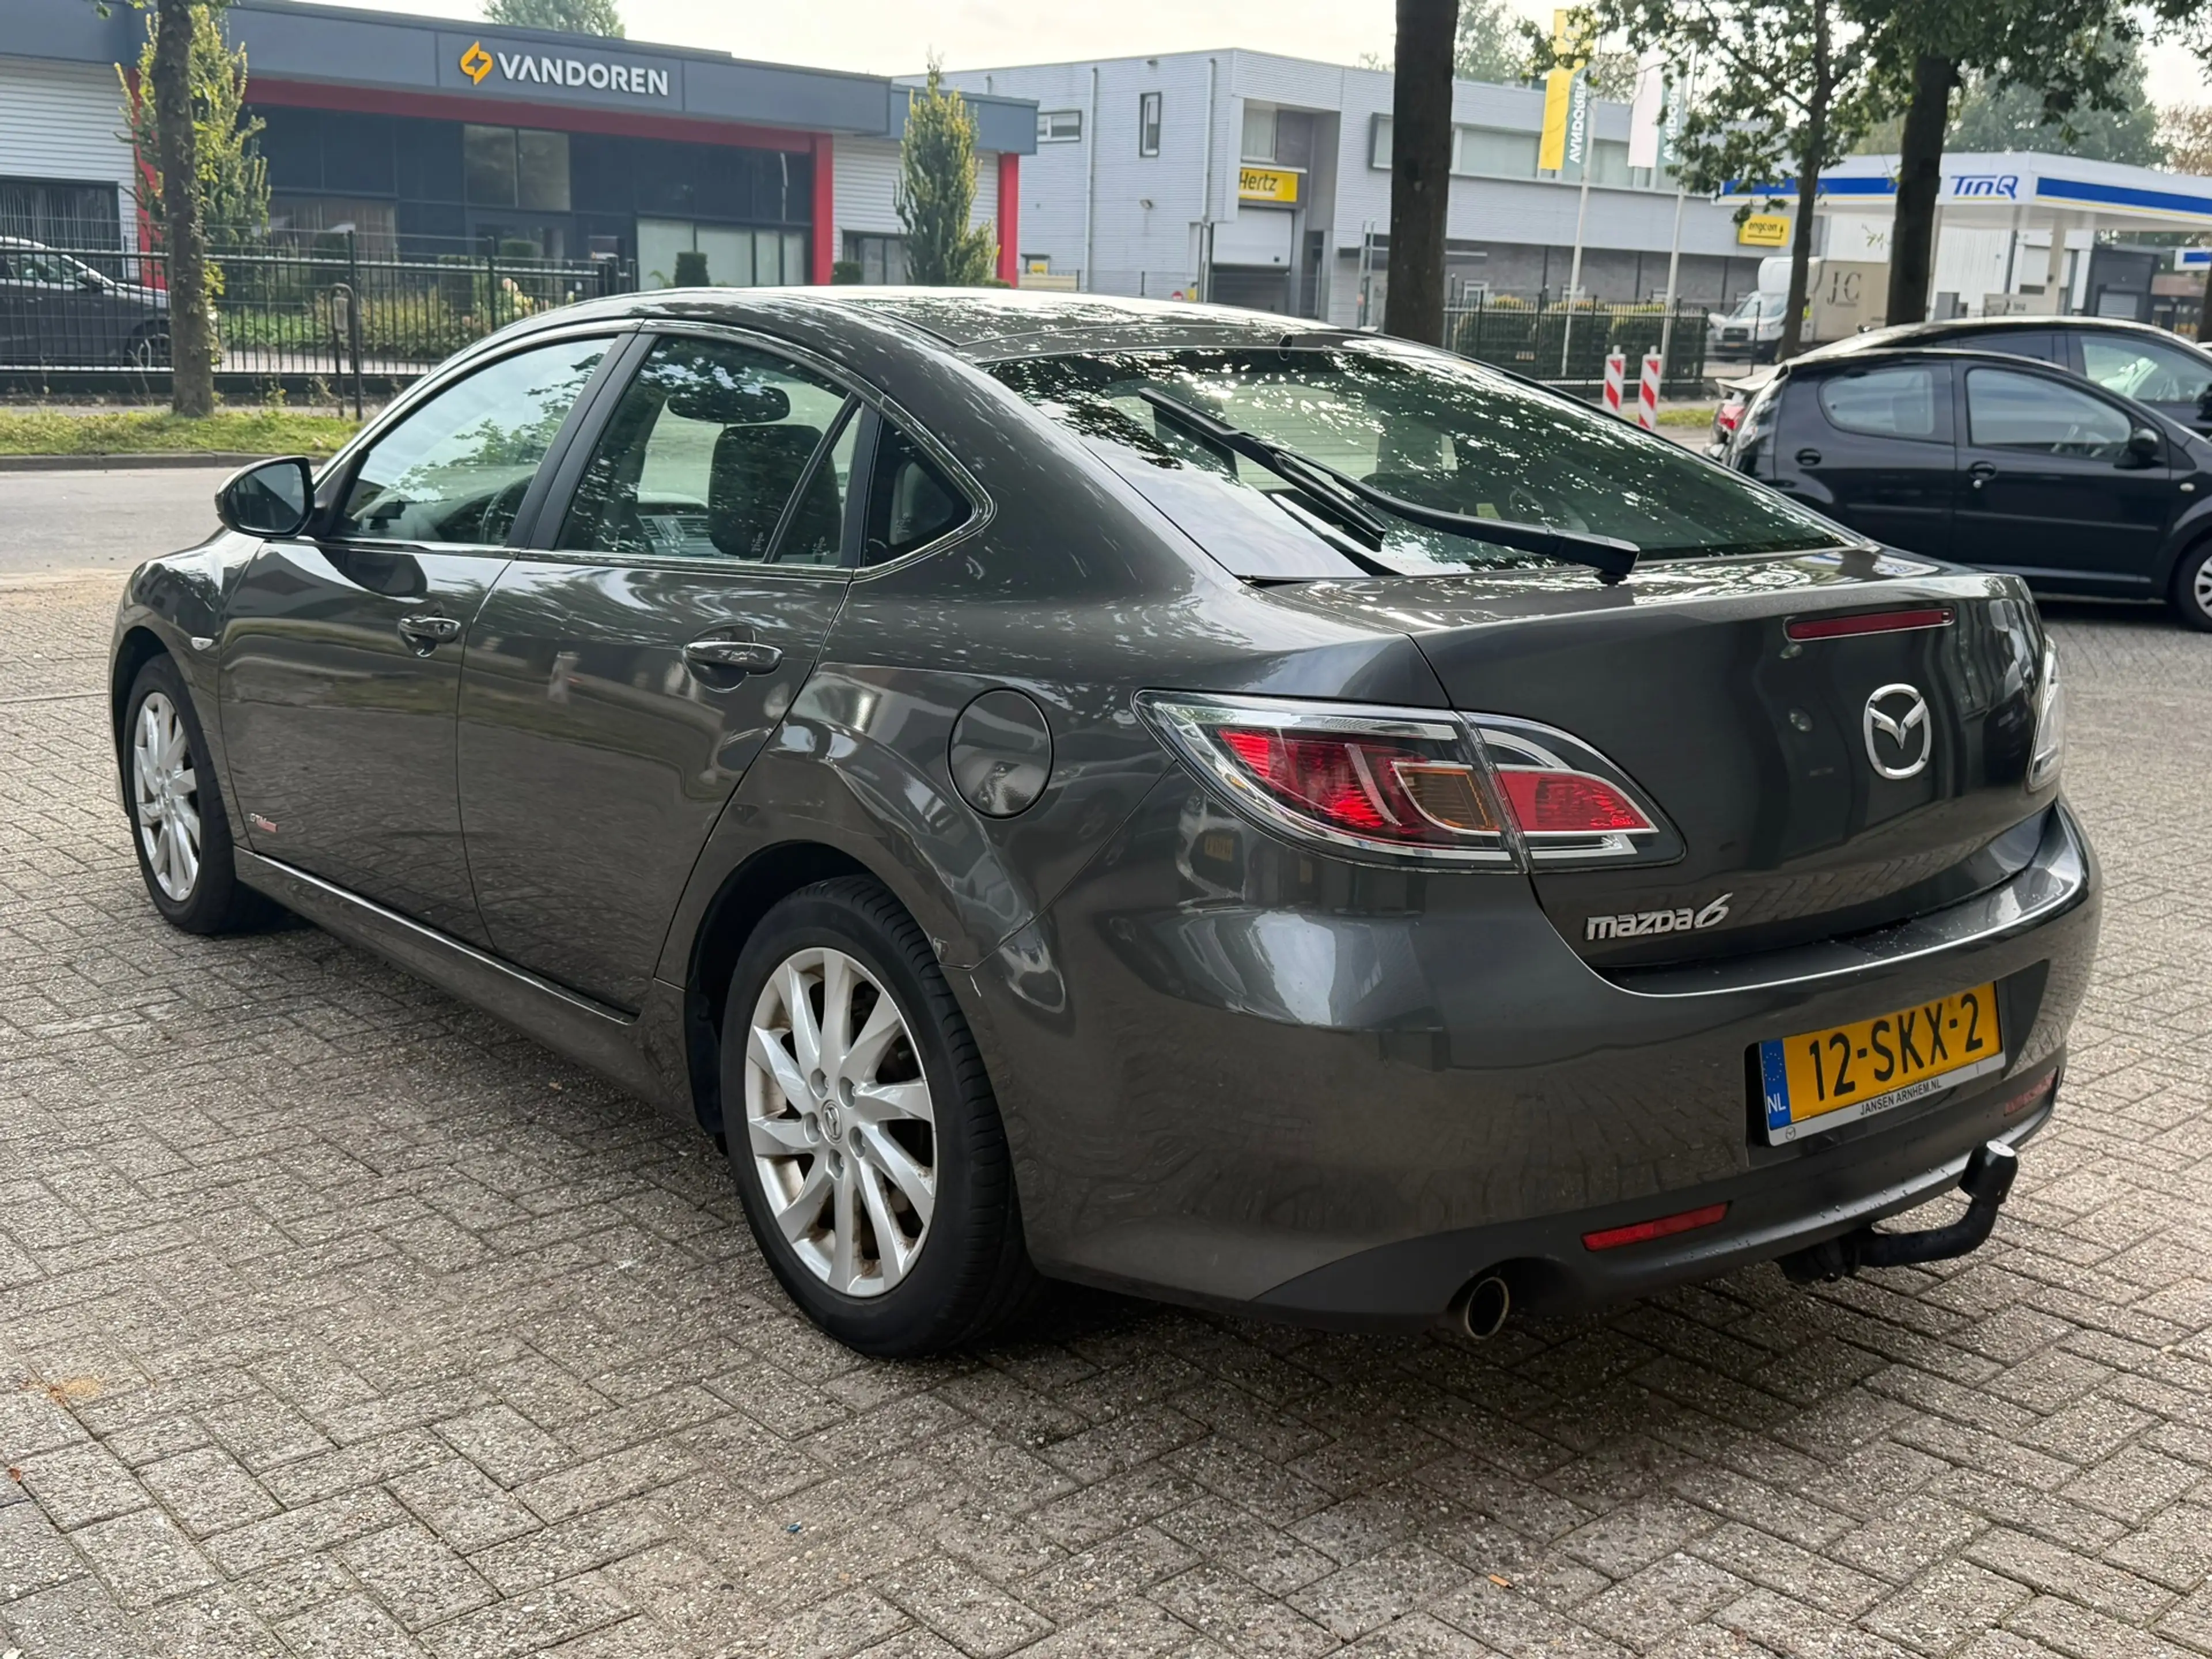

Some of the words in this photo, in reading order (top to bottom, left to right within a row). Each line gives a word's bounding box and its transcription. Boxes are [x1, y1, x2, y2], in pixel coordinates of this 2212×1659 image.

[497, 52, 668, 96] VANDOREN
[1240, 172, 1278, 192] Hertz
[1809, 993, 1983, 1102] 12-SKX-2
[1767, 1092, 1786, 1115] NL
[1860, 1094, 1894, 1116] JANSEN
[1896, 1078, 1942, 1103] ARNHEM.NL
